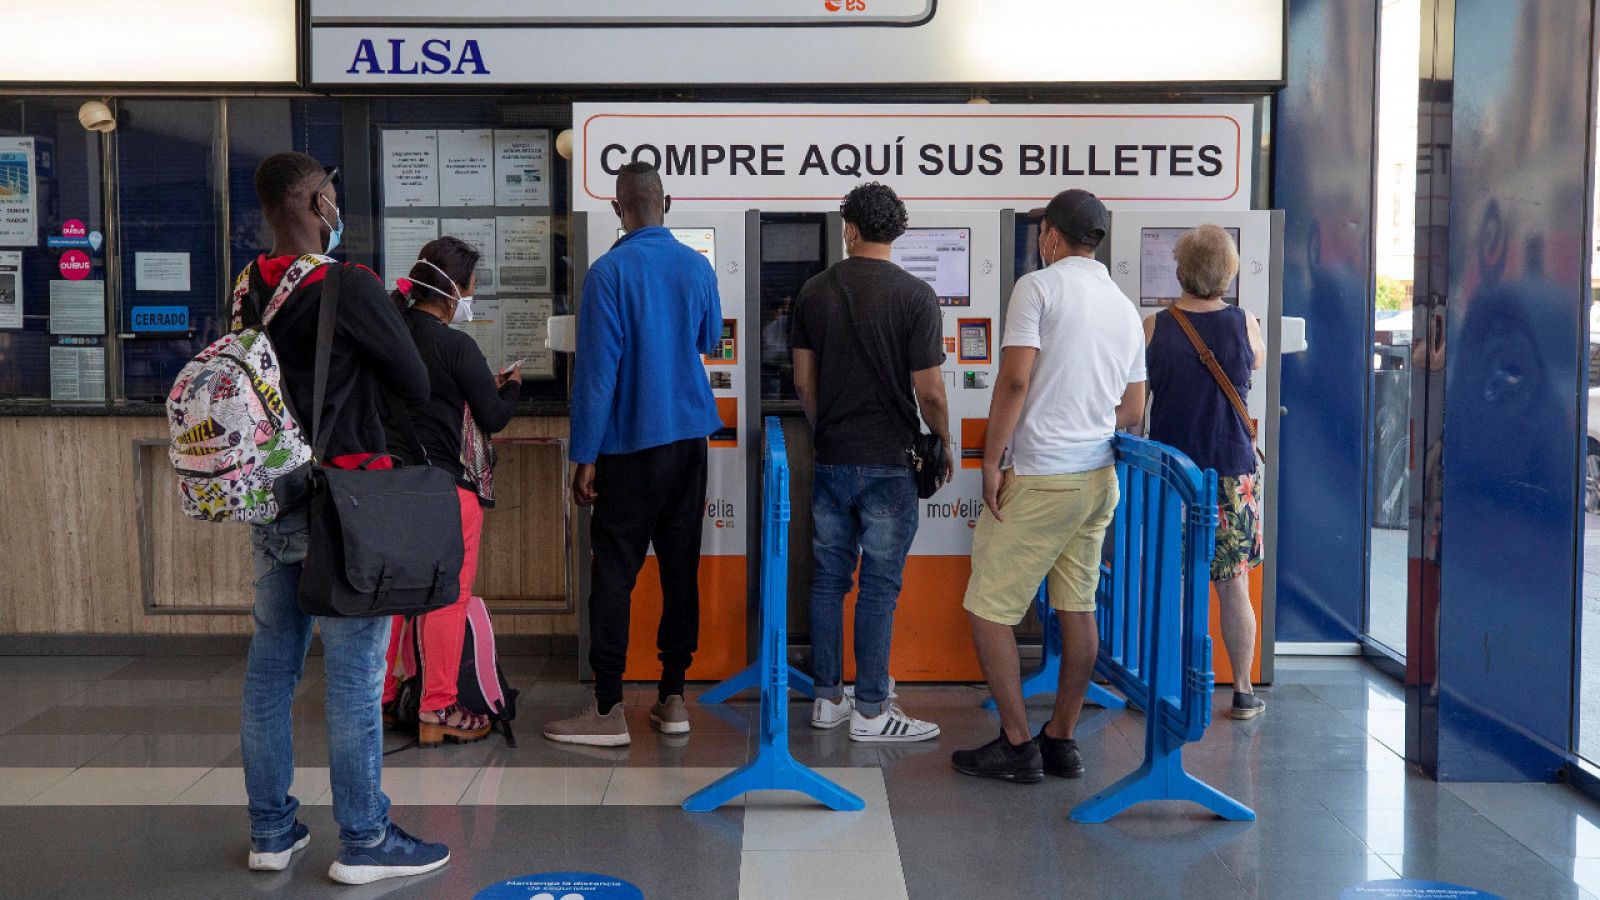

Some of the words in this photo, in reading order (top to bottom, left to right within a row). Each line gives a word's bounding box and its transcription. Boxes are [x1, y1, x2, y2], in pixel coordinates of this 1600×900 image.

[346, 38, 490, 74] ALSA
[600, 143, 785, 176] COMPRE
[798, 136, 905, 178] AQUÍ
[918, 143, 1003, 176] SUS
[1019, 143, 1223, 176] BILLETES
[60, 258, 90, 270] OUIBUS
[135, 313, 186, 326] CERRADO
